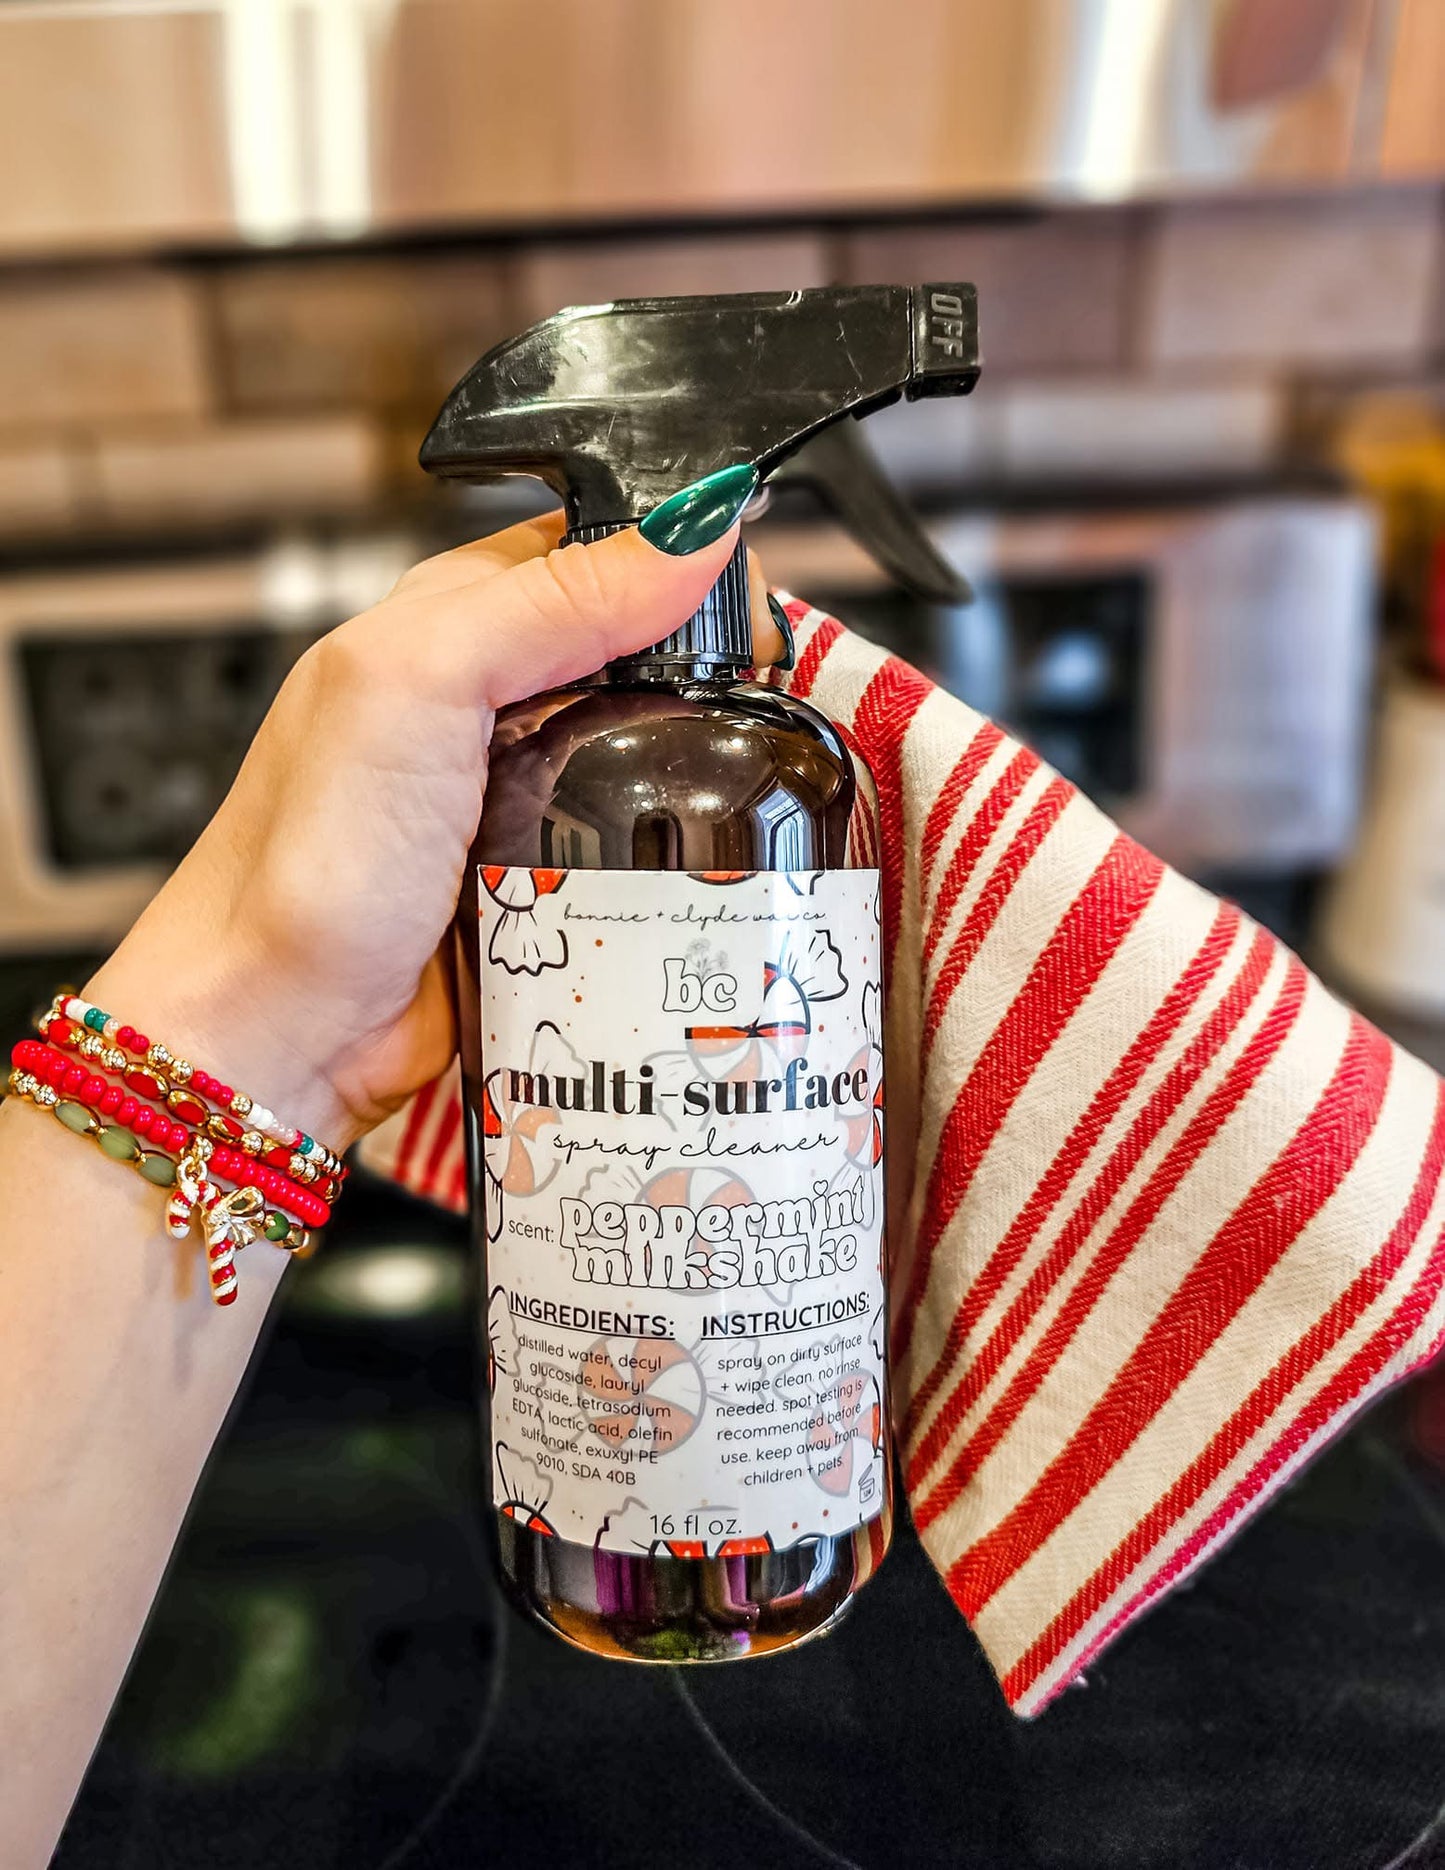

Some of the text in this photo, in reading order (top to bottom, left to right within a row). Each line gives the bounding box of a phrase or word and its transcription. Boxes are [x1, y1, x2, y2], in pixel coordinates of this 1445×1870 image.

[931, 292, 964, 358] OFF
[563, 902, 650, 923] bonnie
[670, 903, 748, 932] clyde
[662, 957, 738, 1013] bc
[507, 1056, 869, 1117] multi-surface
[552, 1126, 840, 1171] spray cleaner
[508, 1174, 866, 1252] scent: peppermint
[509, 1290, 676, 1337] INGREDIENTS:
[701, 1291, 871, 1338] INSTRUCTIONS:
[518, 1334, 663, 1372] distilled water, decyl
[717, 1333, 863, 1373] spray on dirty surface
[529, 1362, 646, 1396] glucoside, lauryl
[720, 1357, 861, 1394] + wipe clean. no rinse
[577, 1396, 672, 1418] tetrasodium
[715, 1378, 863, 1418] needed. spot testing is
[548, 1411, 585, 1433] lactic
[588, 1424, 624, 1440] acid,
[627, 1426, 673, 1442] olefin
[716, 1402, 862, 1442] recommended before
[520, 1425, 659, 1466] sulfonate, exuxyl PE
[720, 1426, 860, 1465] use. keep away from
[536, 1451, 637, 1487] 9010, SDA 40B
[743, 1454, 844, 1487] children + pets
[649, 1514, 743, 1536] 16 fl oz.
